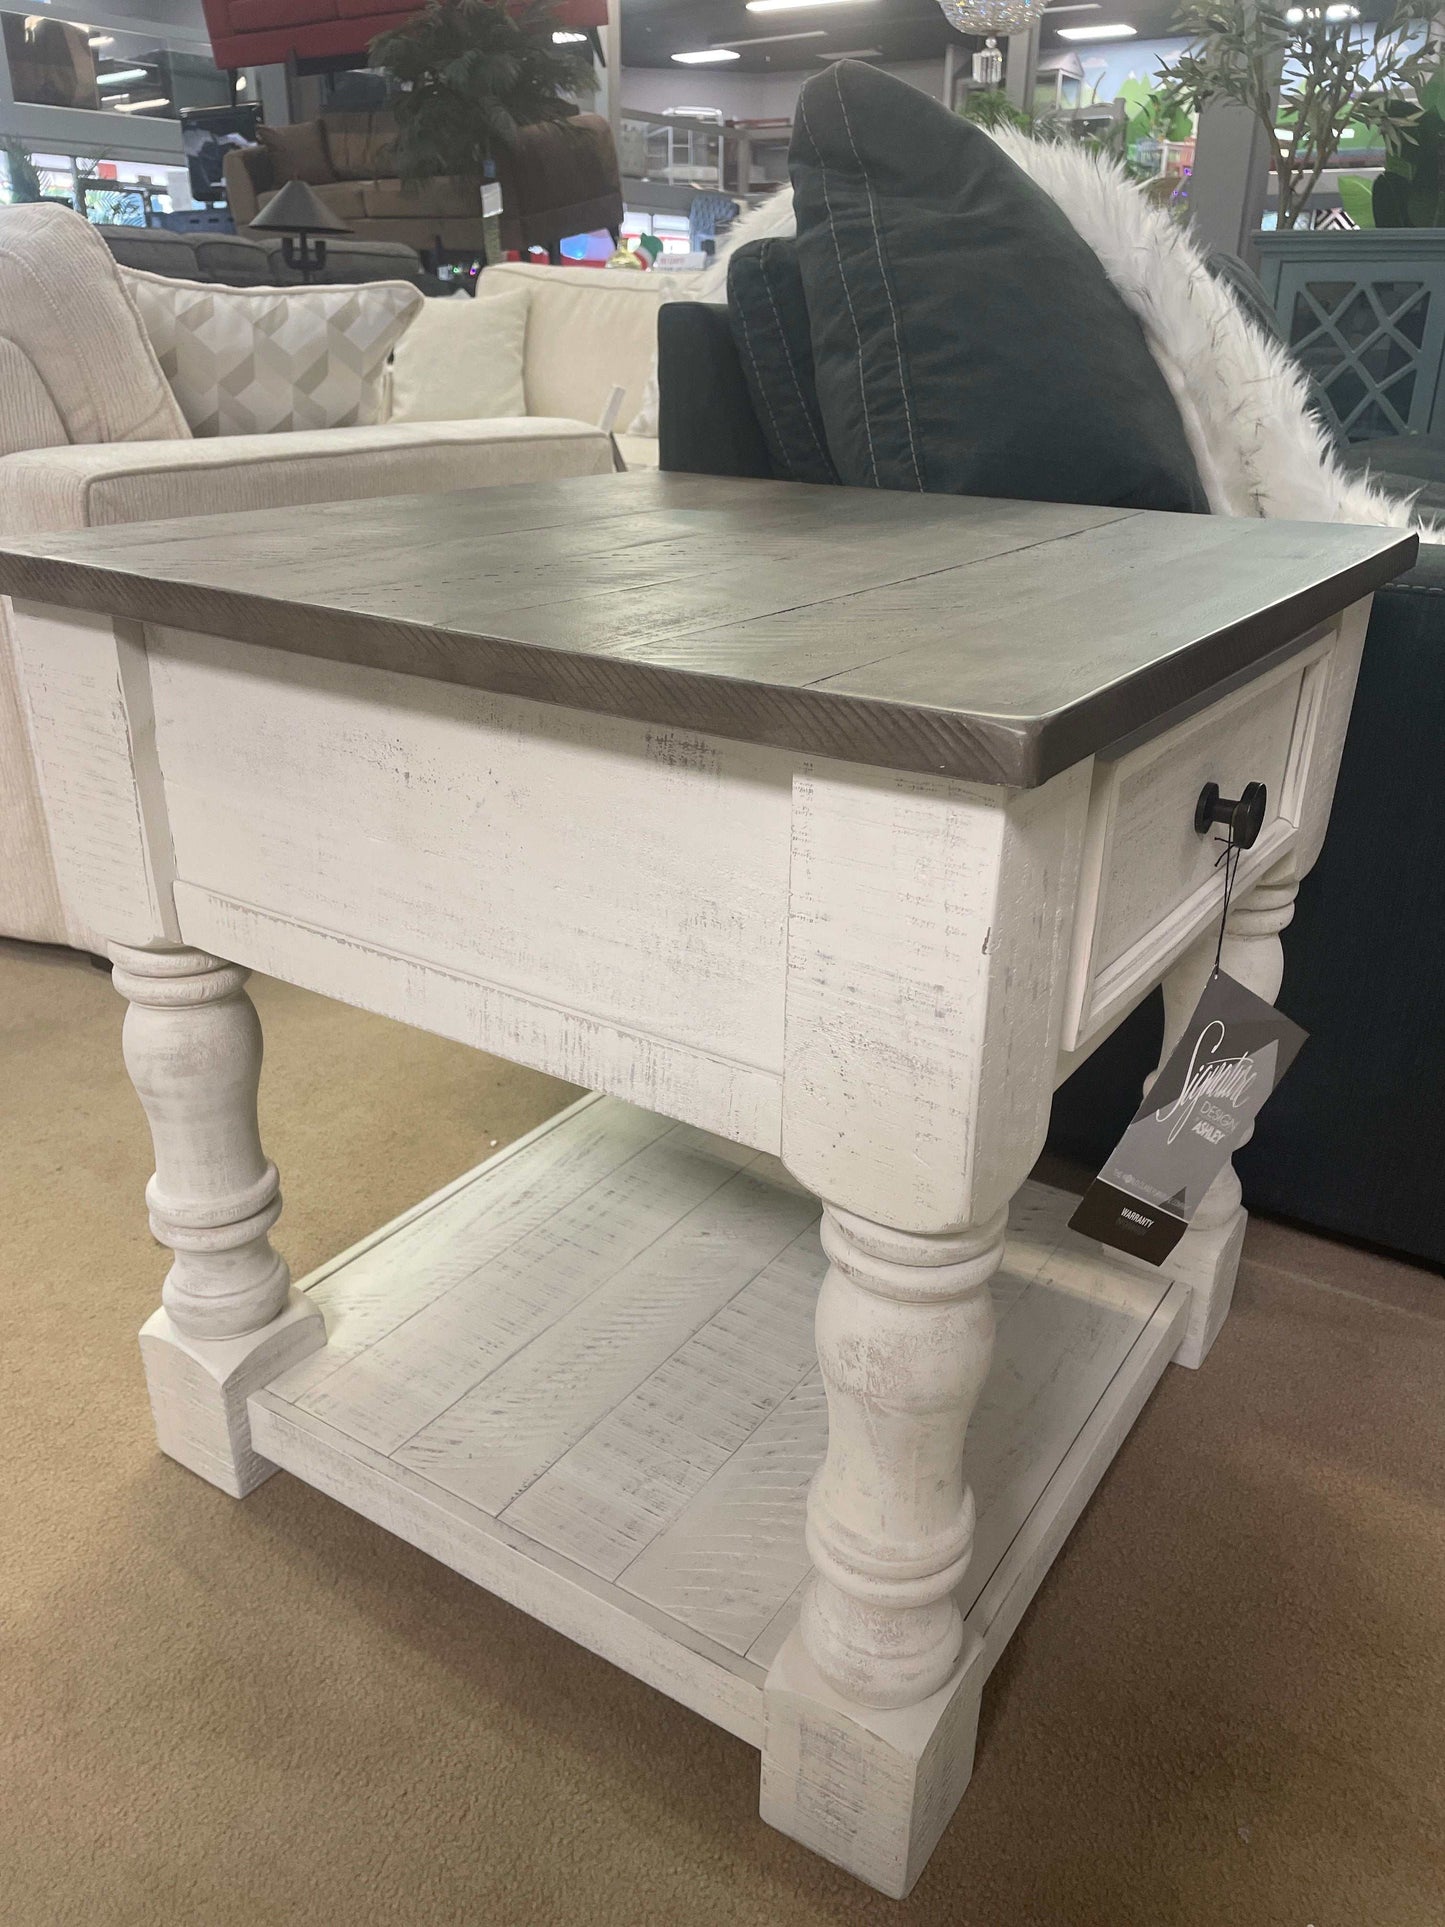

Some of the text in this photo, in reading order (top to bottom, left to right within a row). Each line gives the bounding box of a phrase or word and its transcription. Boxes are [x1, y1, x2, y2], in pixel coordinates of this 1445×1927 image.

[1156, 1020, 1257, 1145] Signature
[1200, 1101, 1237, 1132] DESIGN
[1191, 1120, 1225, 1145] ASHLEY
[1120, 1207, 1154, 1229] WARRANTY
